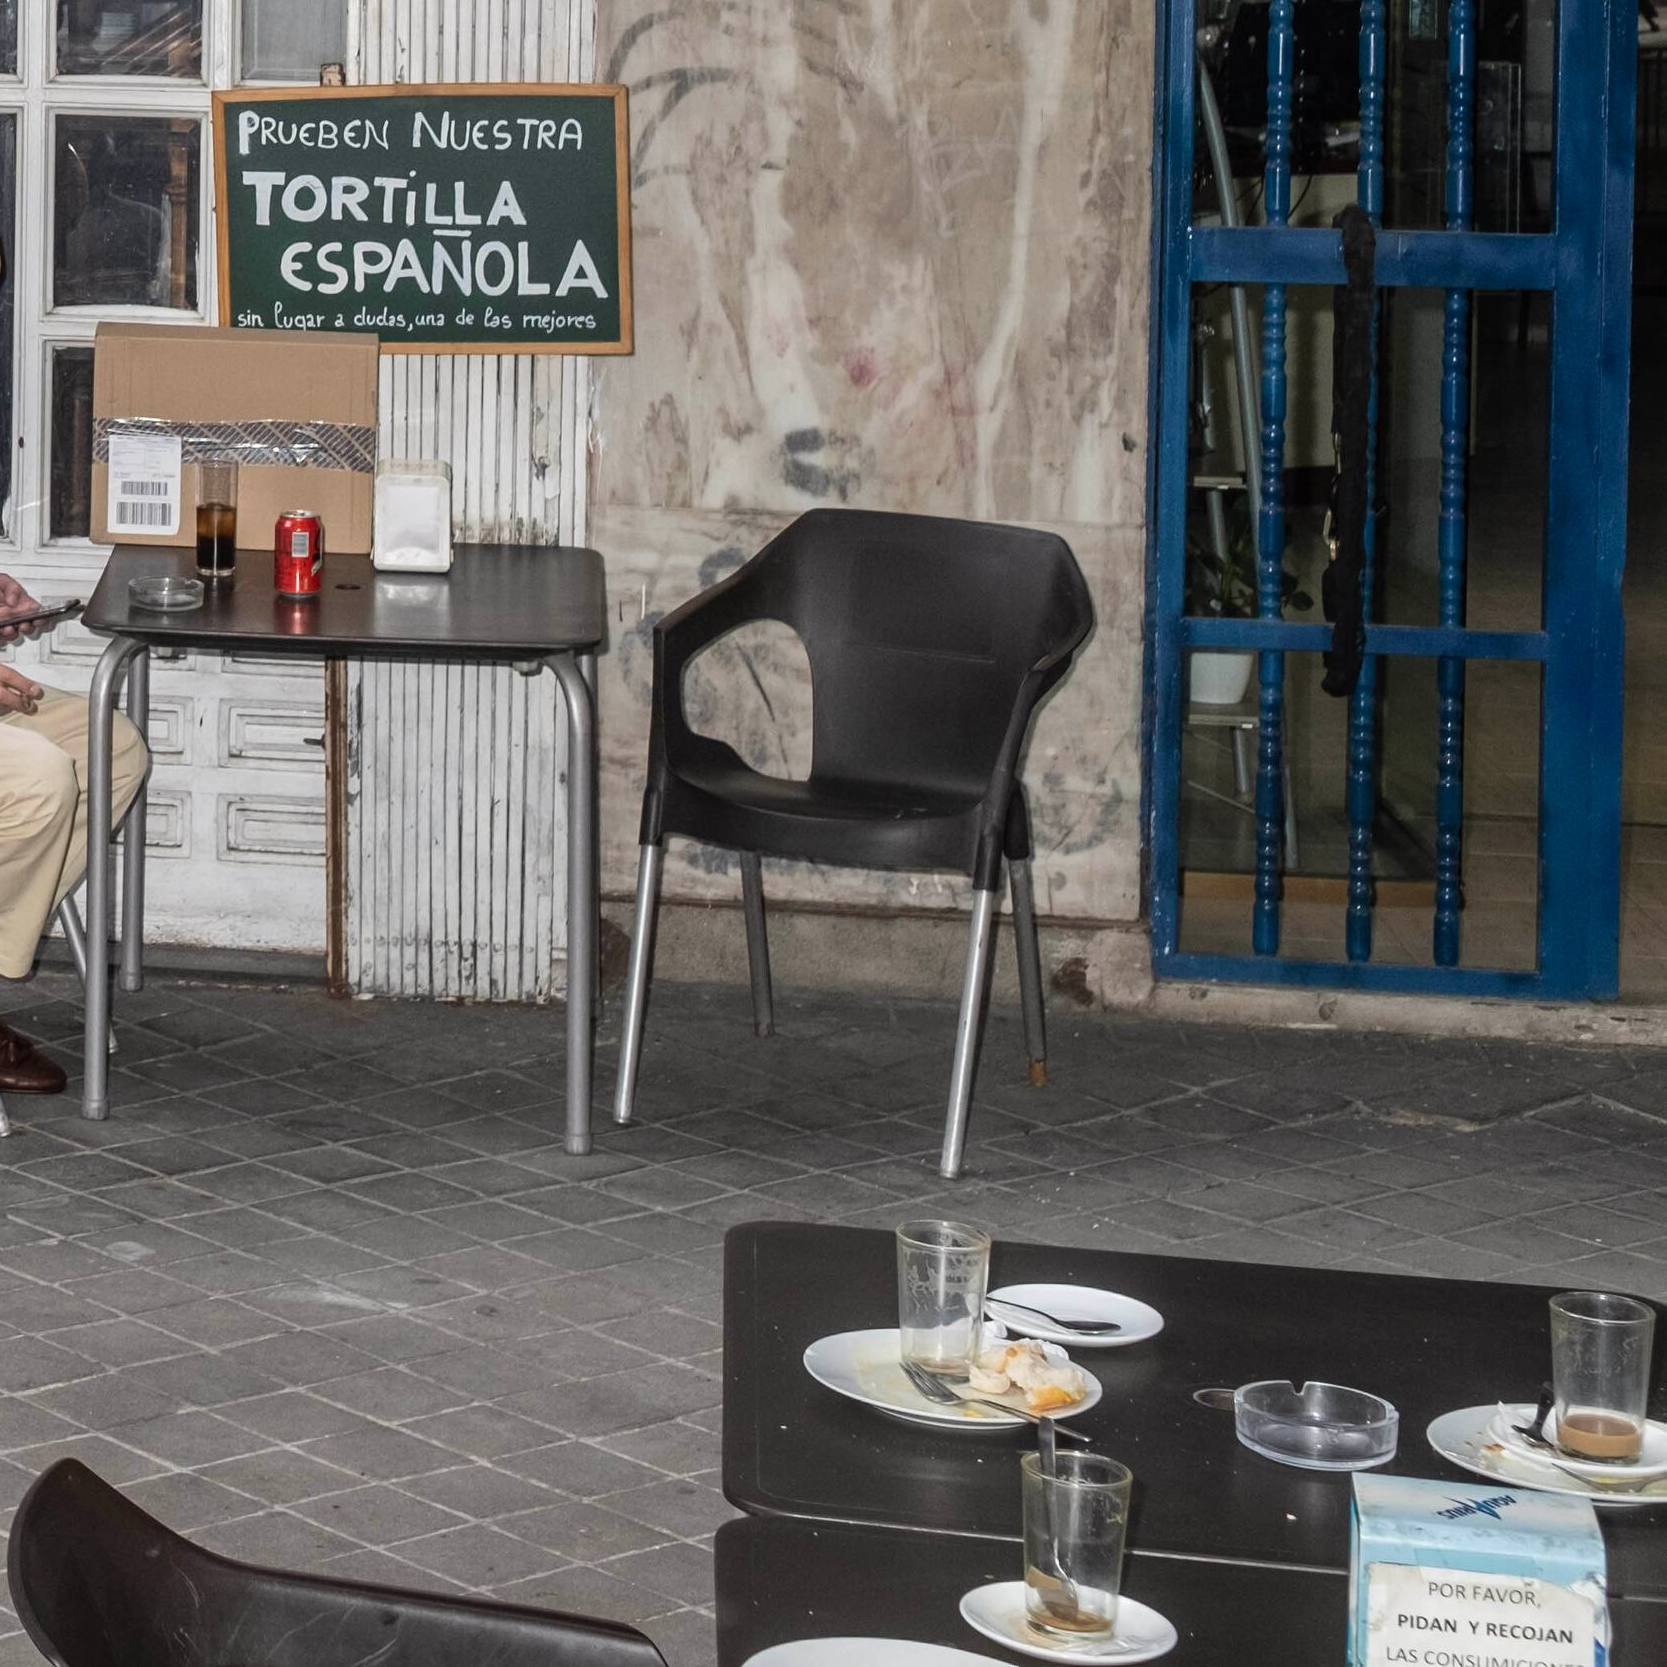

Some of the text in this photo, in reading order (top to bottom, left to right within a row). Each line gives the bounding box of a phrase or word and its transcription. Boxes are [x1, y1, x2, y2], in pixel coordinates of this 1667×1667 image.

[238, 110, 583, 156] PRUEBEN NUESTRA
[280, 229, 609, 299] ESPAÑOLA
[237, 311, 264, 328] sin
[274, 301, 325, 331] lugar
[335, 313, 344, 327] a
[415, 312, 445, 327] una
[455, 308, 475, 325] de
[485, 307, 512, 328] las
[522, 311, 597, 334] mejores
[1437, 1495, 1517, 1521] AQUARIUS
[1428, 1581, 1542, 1609] POR FAVOR,
[1397, 1613, 1573, 1644] PIDAN Y RECOJAN
[1386, 1646, 1586, 1667] LAS CONSUMICI
